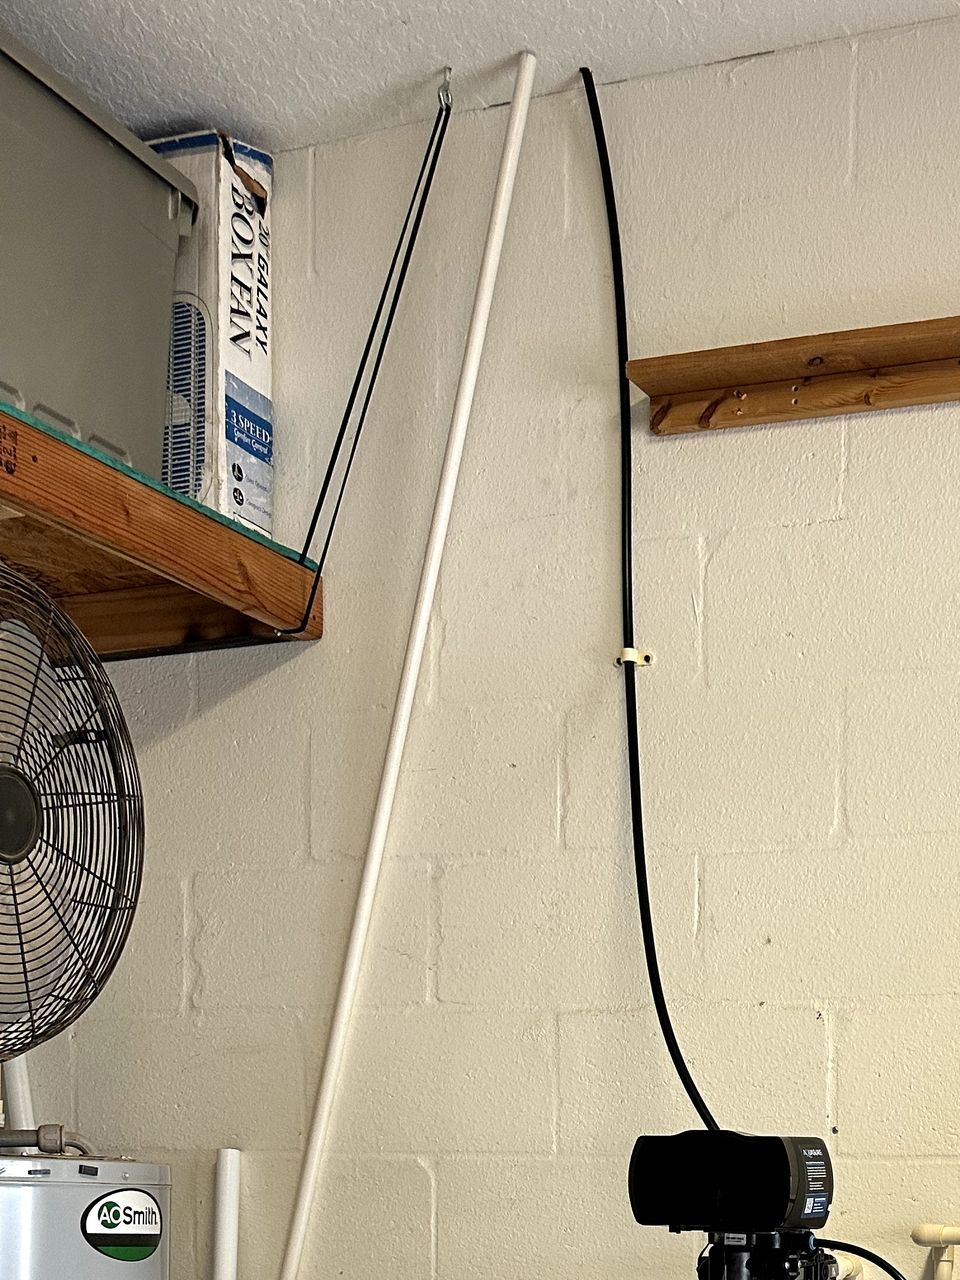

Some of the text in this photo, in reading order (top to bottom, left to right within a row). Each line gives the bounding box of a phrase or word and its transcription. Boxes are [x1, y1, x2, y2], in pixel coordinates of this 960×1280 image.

[229, 272, 253, 361] FAN
[255, 254, 269, 355] GALAXY
[231, 410, 271, 443] 3 SPEED
[122, 1206, 158, 1225] Smith
